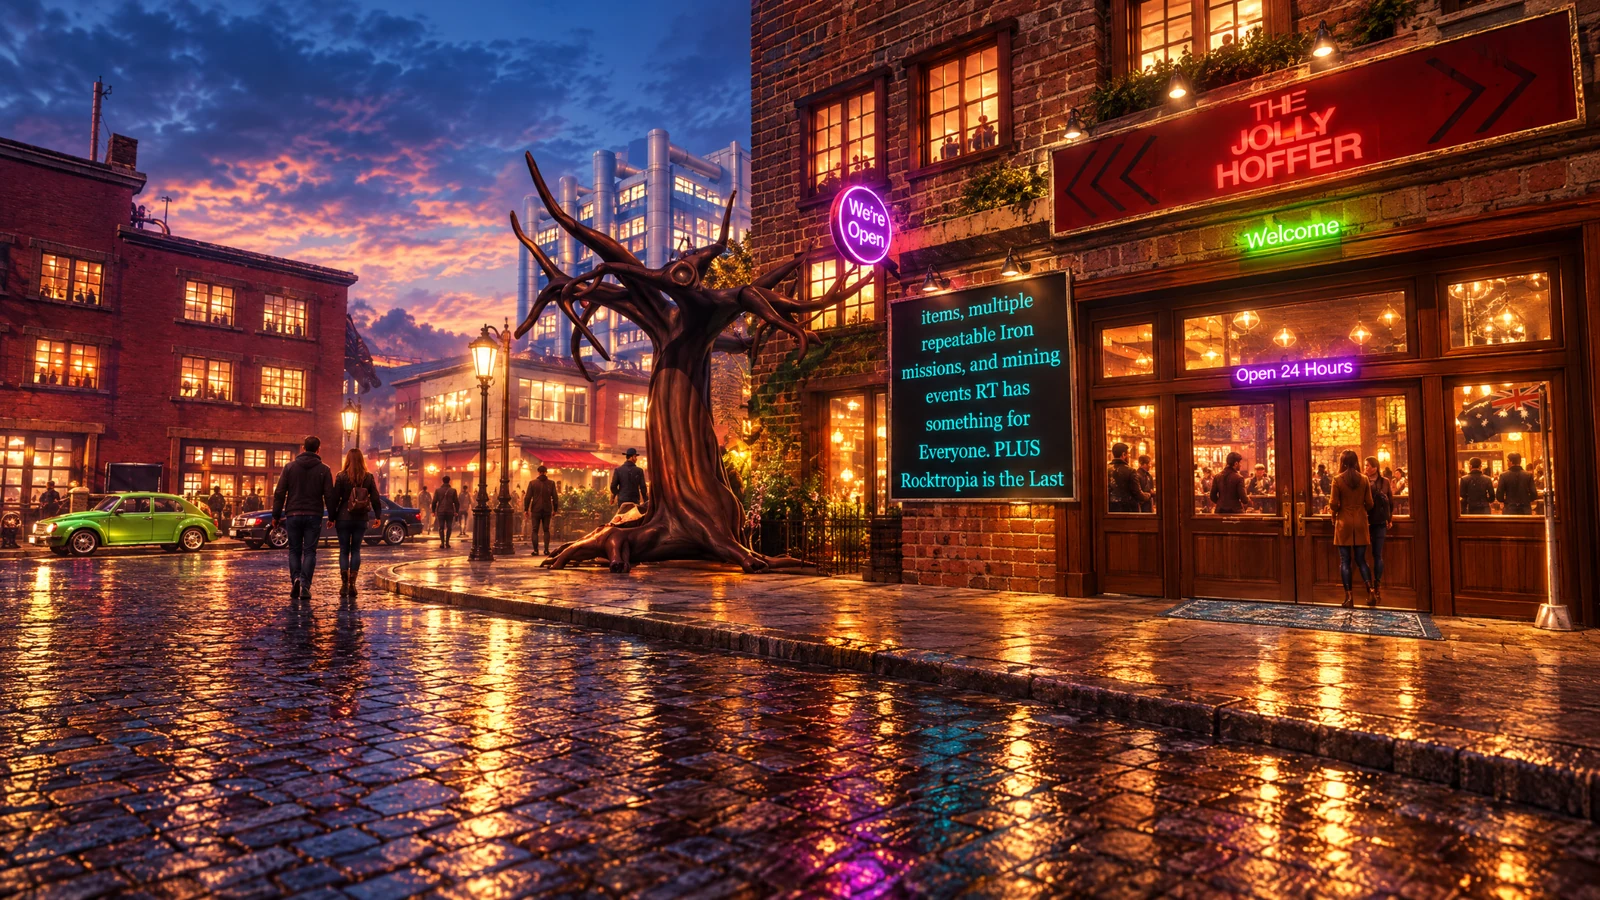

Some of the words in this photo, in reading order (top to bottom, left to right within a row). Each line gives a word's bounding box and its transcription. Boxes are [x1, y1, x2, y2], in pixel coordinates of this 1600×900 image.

[1250, 89, 1307, 121] THE
[1231, 106, 1336, 155] JOLLY
[1216, 132, 1363, 189] HOFFER
[848, 197, 886, 227] We're
[848, 221, 884, 248] Open
[1244, 220, 1340, 249] Welcome
[921, 308, 965, 325] items,
[968, 293, 1034, 317] multiple
[921, 326, 996, 353] repeatable
[1000, 324, 1035, 341] Iron
[901, 360, 966, 380] missions,
[969, 352, 999, 372] and
[1002, 347, 1061, 369] mining
[1236, 368, 1276, 384] Open
[1281, 364, 1300, 378] 24
[1305, 362, 1353, 376] Hours
[925, 387, 972, 404] events
[975, 382, 999, 400] RT
[1002, 380, 1031, 397] has
[925, 412, 1003, 432] something
[1006, 409, 1031, 427] for
[918, 444, 991, 463] Everyone.
[994, 439, 1041, 458] PLUS
[901, 471, 979, 492] Rocktropia
[982, 470, 996, 487] is
[998, 469, 1025, 487] the
[1028, 470, 1065, 487] Last
